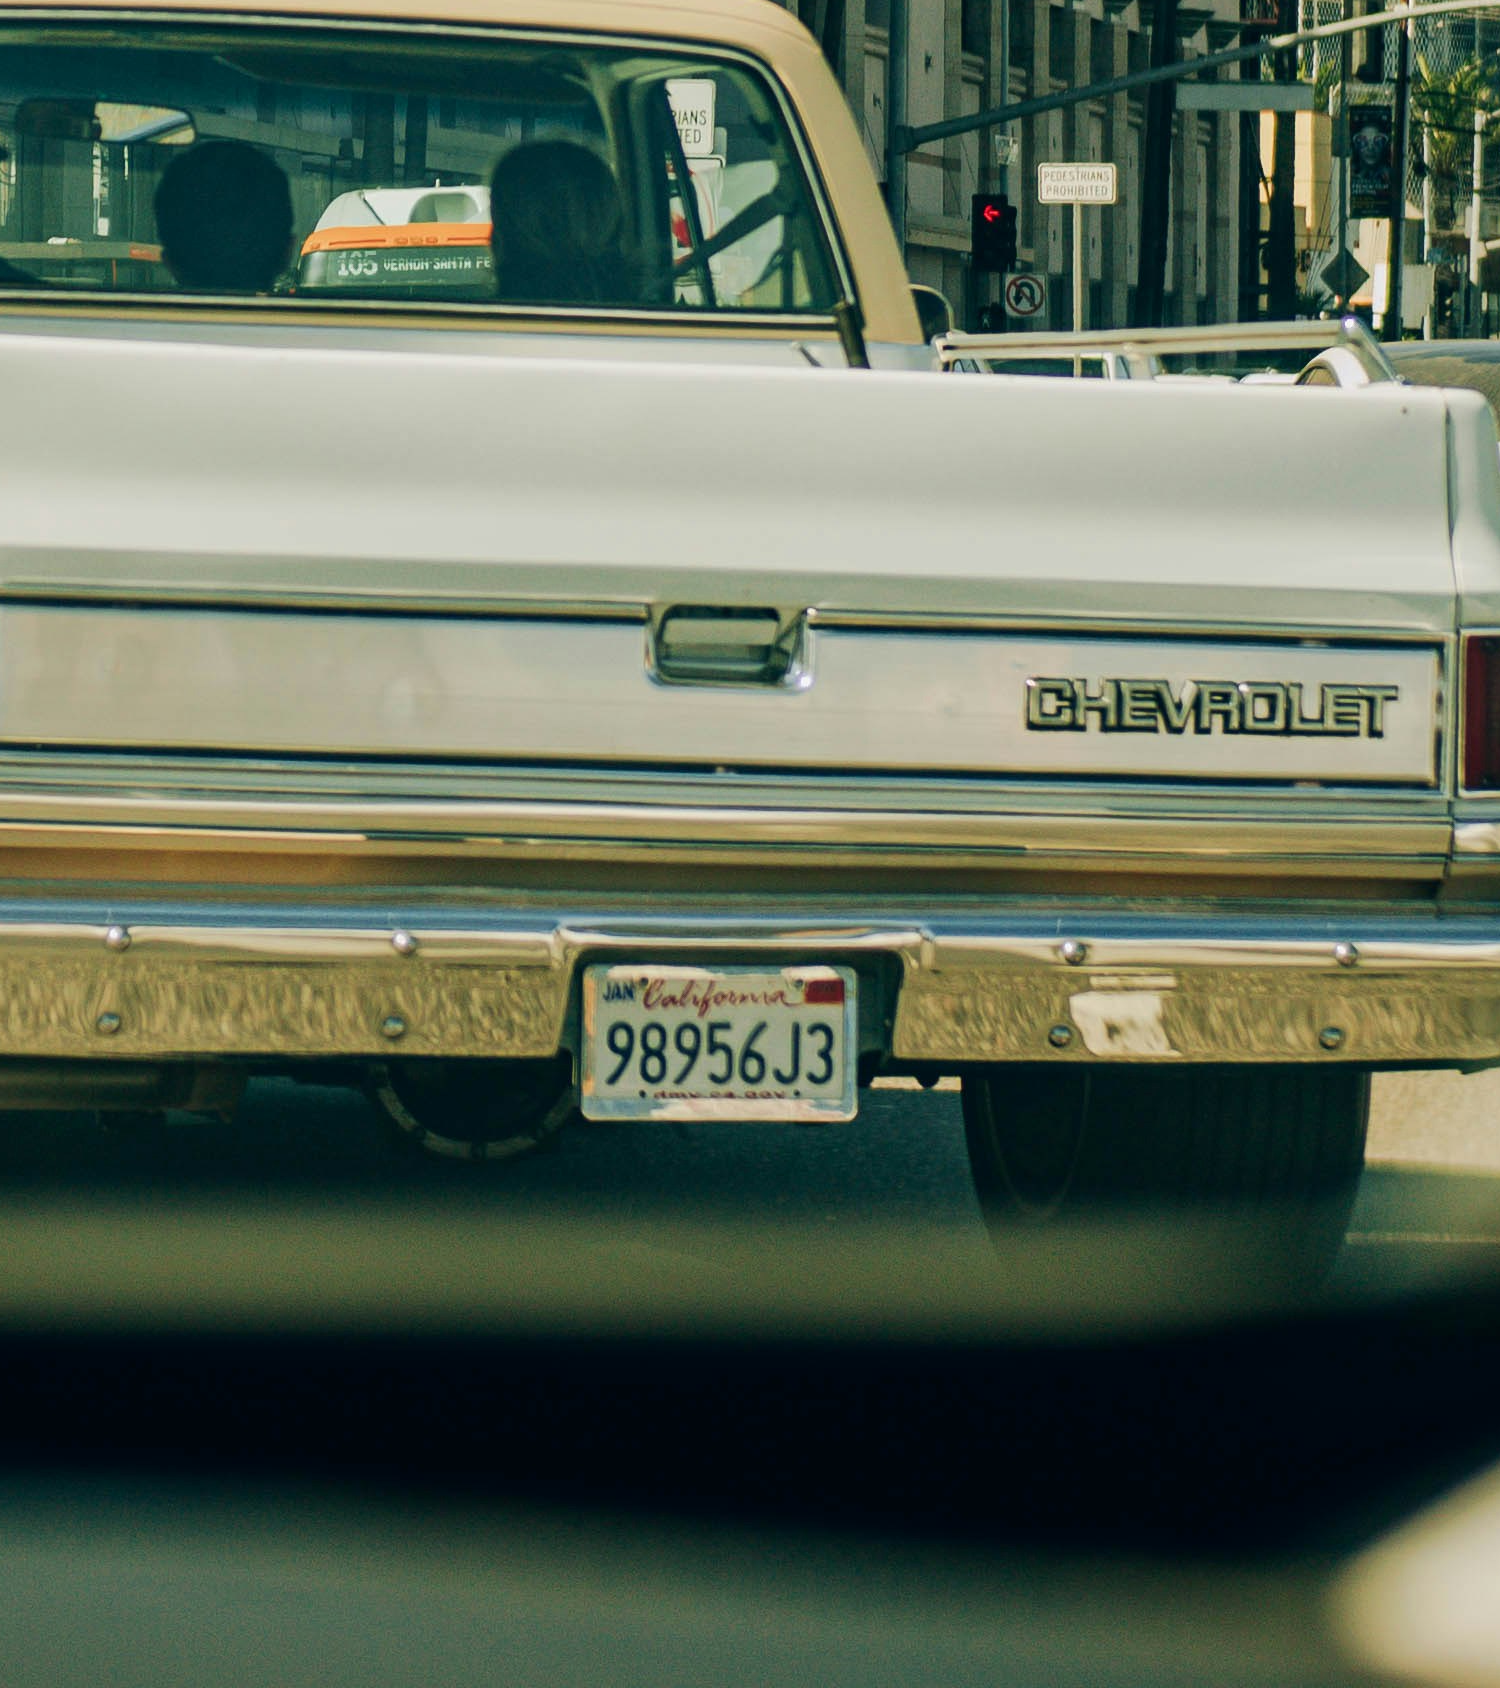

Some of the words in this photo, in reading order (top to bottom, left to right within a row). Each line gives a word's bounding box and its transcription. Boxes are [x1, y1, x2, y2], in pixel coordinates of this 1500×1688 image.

[1044, 171, 1110, 182] PEDESTRIANS
[1045, 185, 1108, 197] PROHIBITED
[337, 250, 378, 276] 105
[476, 256, 491, 269] FE
[1026, 676, 1399, 738] CHEVROLET
[603, 980, 636, 1002] JAN
[643, 977, 802, 1019] California
[605, 1021, 834, 1085] 98956J3
